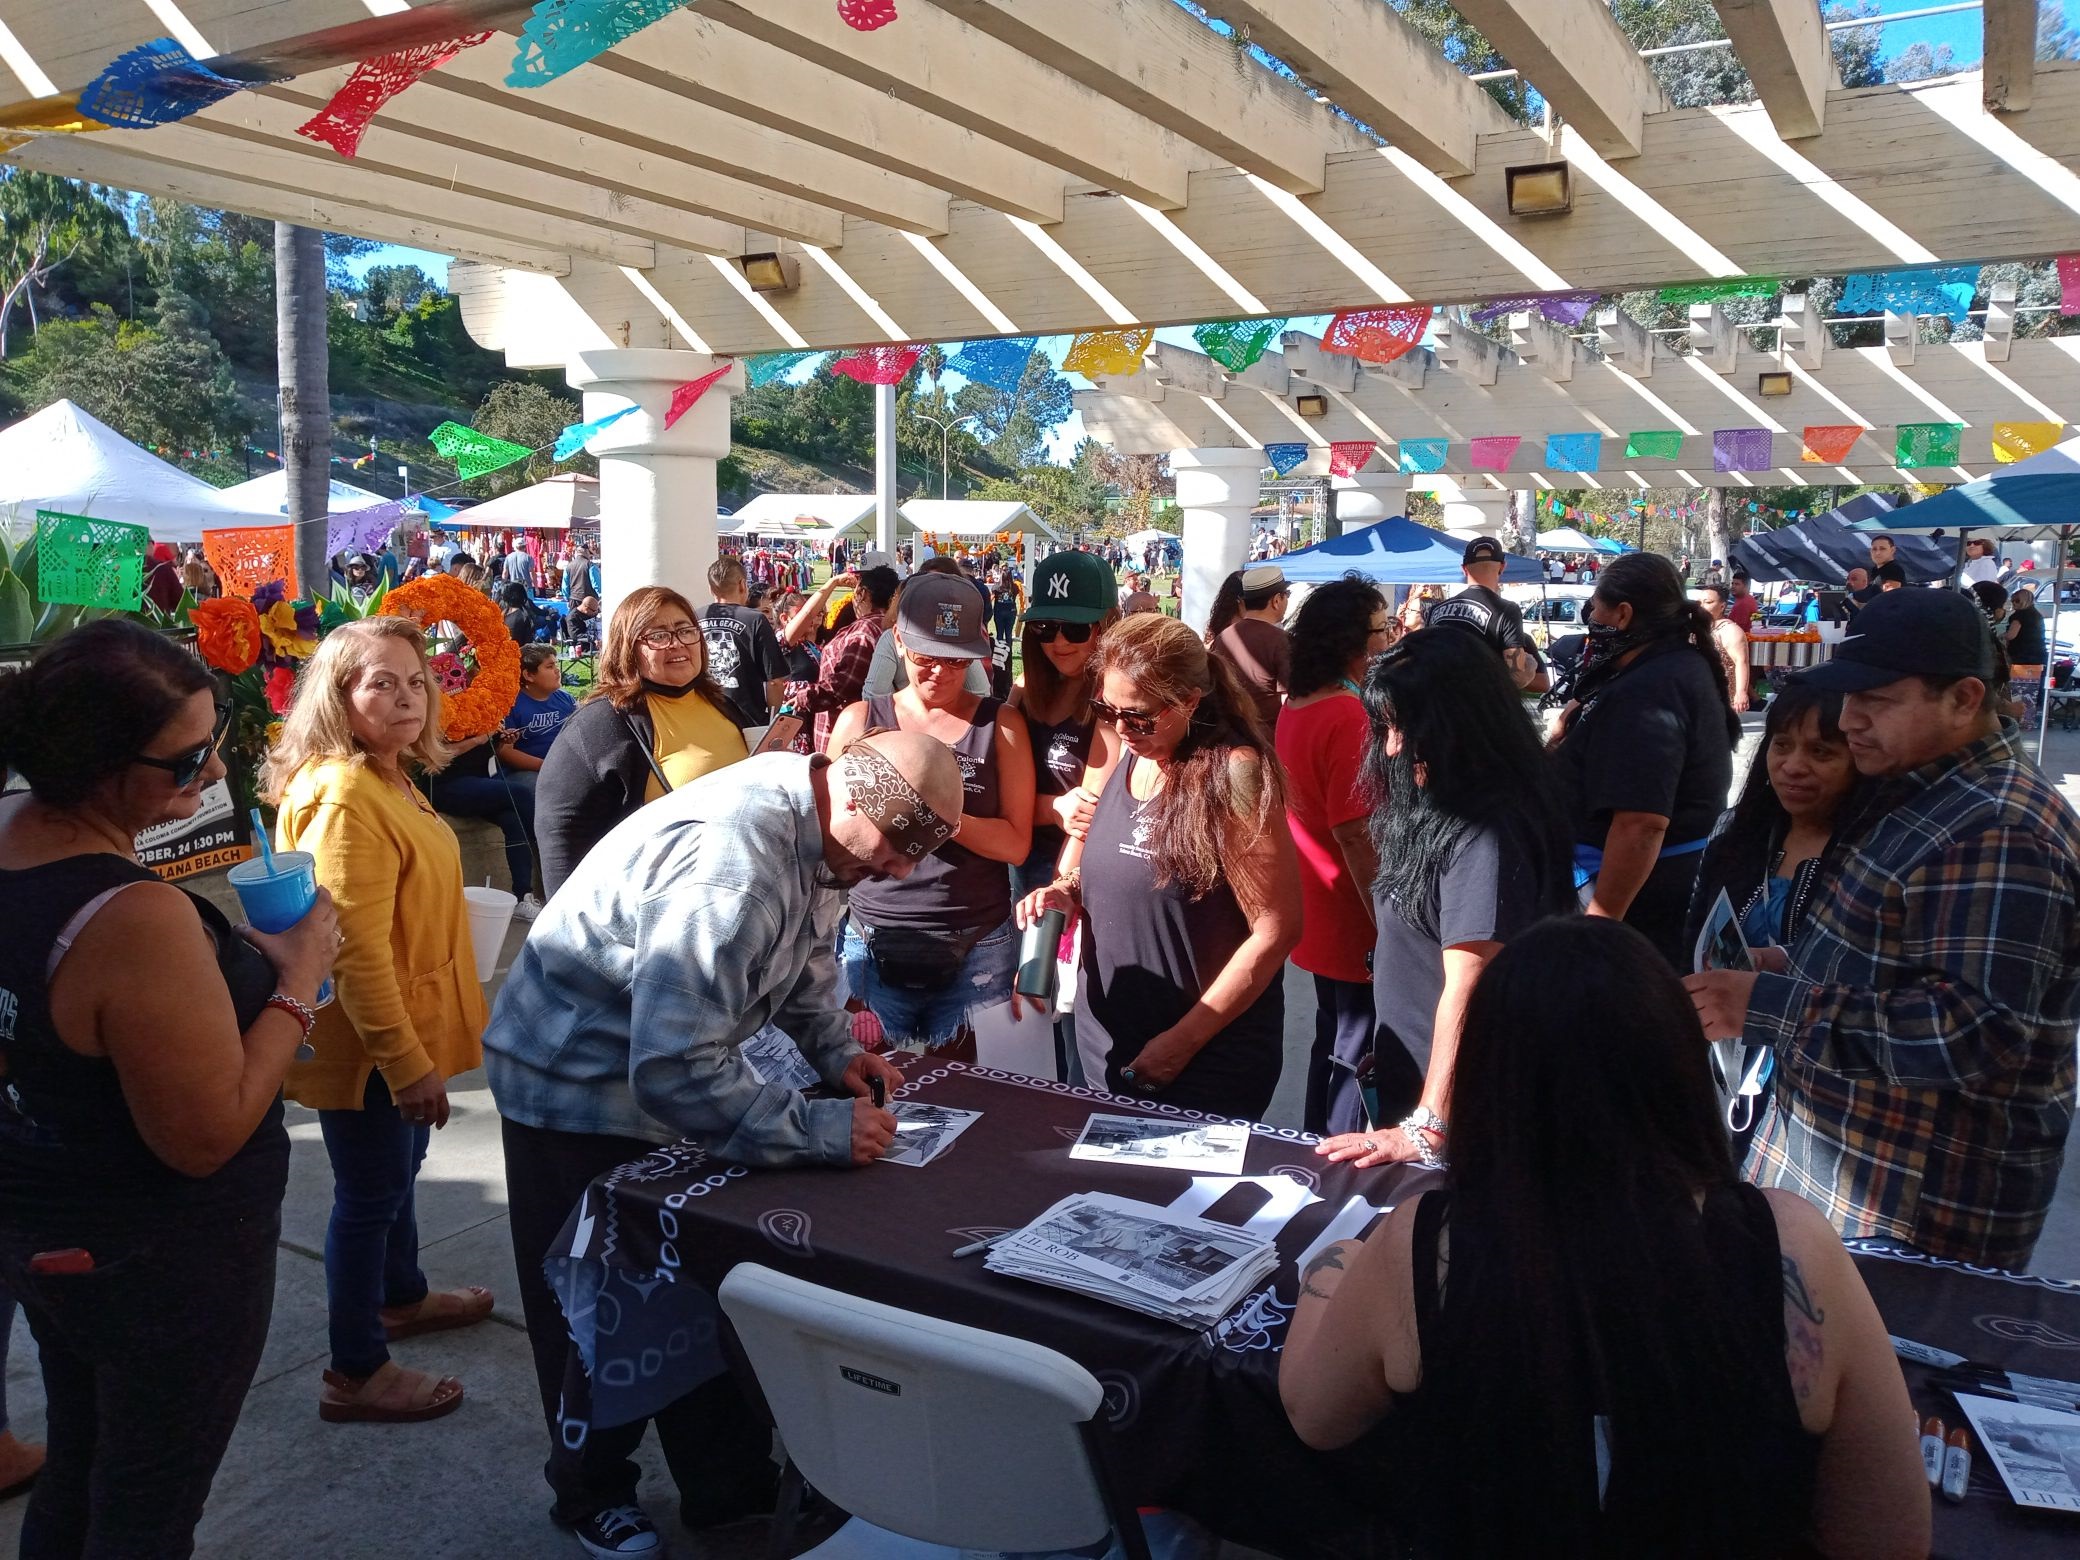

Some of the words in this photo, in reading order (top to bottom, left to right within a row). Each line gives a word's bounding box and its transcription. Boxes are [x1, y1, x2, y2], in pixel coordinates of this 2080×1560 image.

[953, 534, 998, 543] Beautiful
[1047, 572, 1070, 599] NY
[719, 619, 740, 631] GEAR
[531, 711, 560, 728] NIKE
[145, 832, 170, 844] COLONIA
[170, 818, 197, 835] COMMUNITY
[197, 802, 228, 821] FOUNDATION
[136, 847, 176, 864] OBER,
[178, 842, 190, 856] 24
[193, 836, 213, 851] 1:30
[215, 831, 235, 844] PM
[158, 862, 192, 879] LANA
[195, 850, 241, 870] BEACH
[1018, 1233, 1042, 1249] LIL
[1044, 1244, 1081, 1261] ROB
[847, 1371, 893, 1391] LIFETIME
